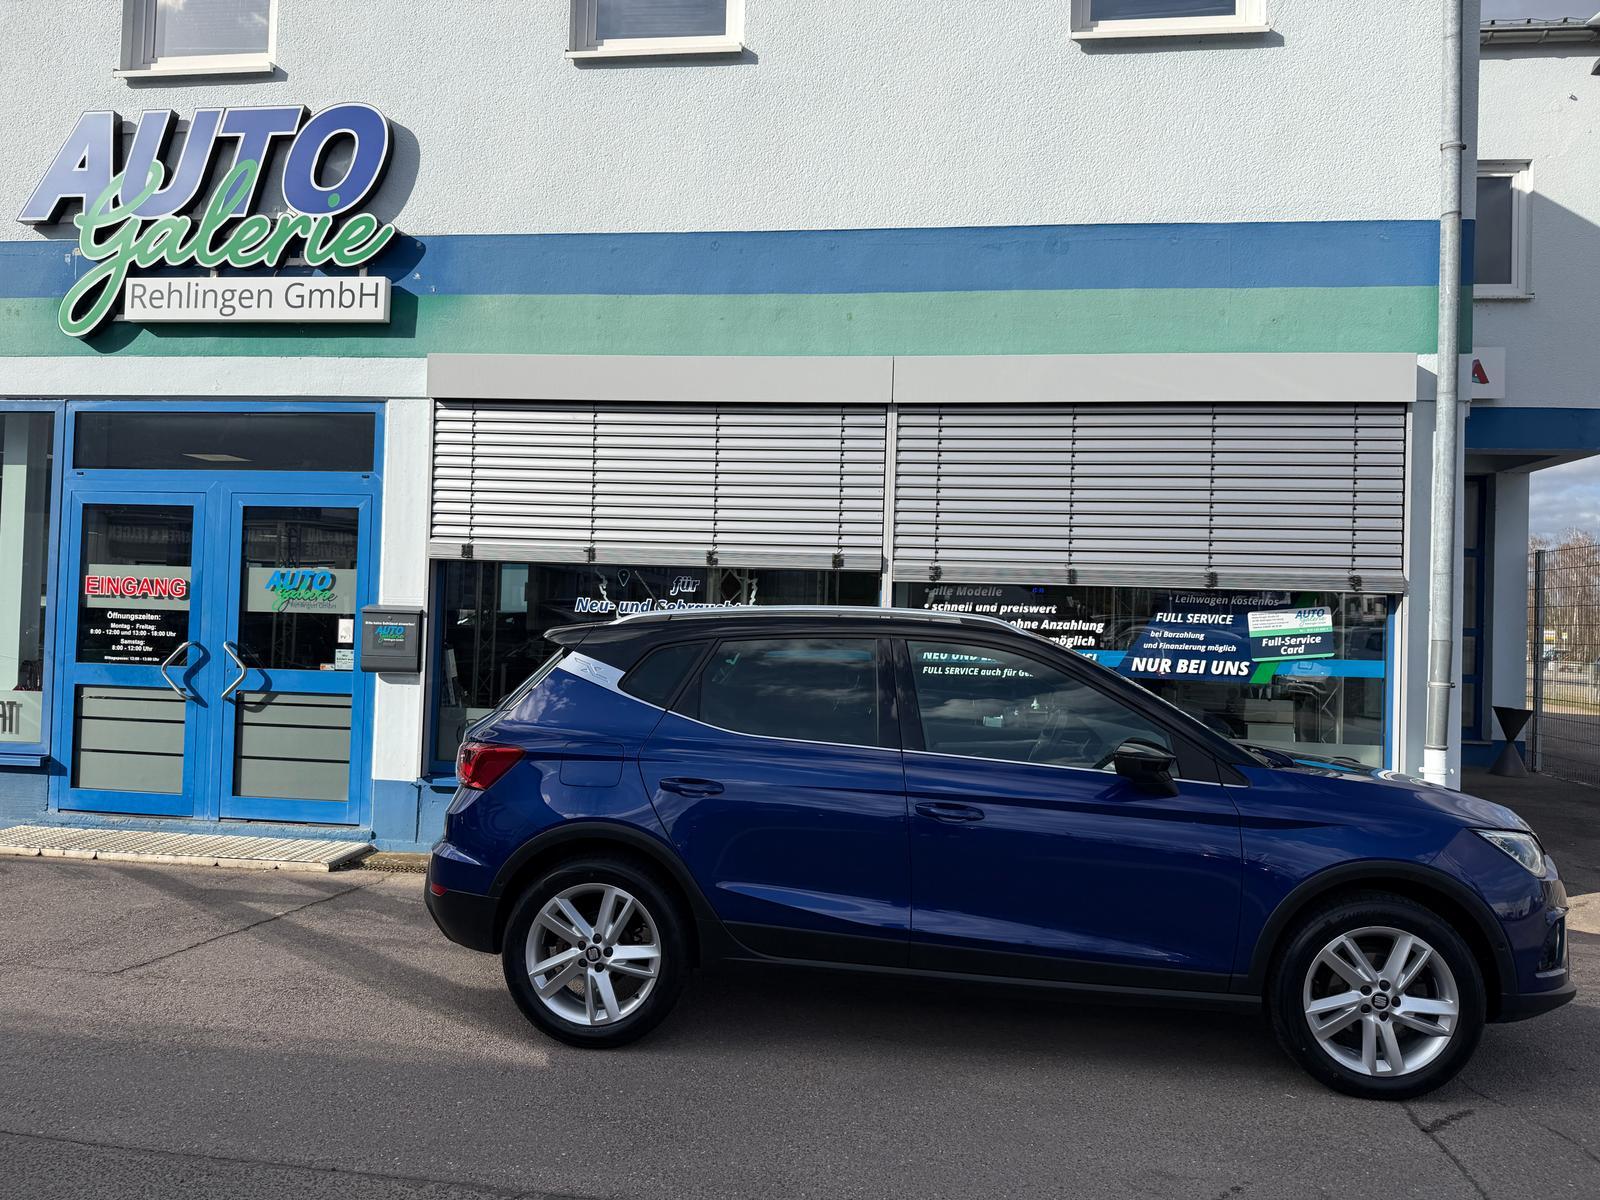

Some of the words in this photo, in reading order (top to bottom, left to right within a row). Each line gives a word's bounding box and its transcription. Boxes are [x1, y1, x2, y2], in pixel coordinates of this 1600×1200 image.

[18, 102, 390, 220] AUTO
[58, 159, 395, 337] Galerie
[130, 282, 273, 316] Rehlingen
[284, 282, 379, 310] GmbH
[85, 575, 186, 597] EINGANG
[265, 570, 332, 590] AUTO
[670, 575, 699, 595] für
[932, 586, 955, 597] alle
[956, 587, 1003, 597] Modelle
[575, 597, 616, 613] Neu-
[619, 598, 652, 613] und
[1175, 594, 1229, 605] Leihwagen
[1230, 595, 1280, 606] kostenlos
[931, 601, 973, 612] schnell
[975, 604, 998, 613] und
[999, 604, 1057, 615] preiswert
[1295, 608, 1325, 619] AUTO
[107, 610, 161, 621] Öffnungszeiten:
[1156, 612, 1184, 623] FULL
[1184, 613, 1234, 625] SERVICE
[110, 622, 131, 630] Montag
[375, 625, 404, 635] AUTO
[1009, 619, 1038, 630] ohne
[1040, 620, 1105, 633] Anzahlung
[1150, 630, 1163, 638] bei
[1163, 631, 1205, 640] Barzahlung
[1262, 635, 1322, 647] Full-Service
[120, 638, 146, 646] Samstag:
[1048, 635, 1096, 649] möglich
[1159, 642, 1206, 652] Finanzierung
[1207, 644, 1237, 653] möglich
[1280, 645, 1305, 655] Card
[922, 666, 942, 674] FULL
[944, 666, 979, 675] SERVICE
[1002, 668, 1017, 678] für
[1131, 657, 1172, 675] NUR
[1176, 659, 1209, 674] BEI
[1210, 661, 1250, 676] UNS
